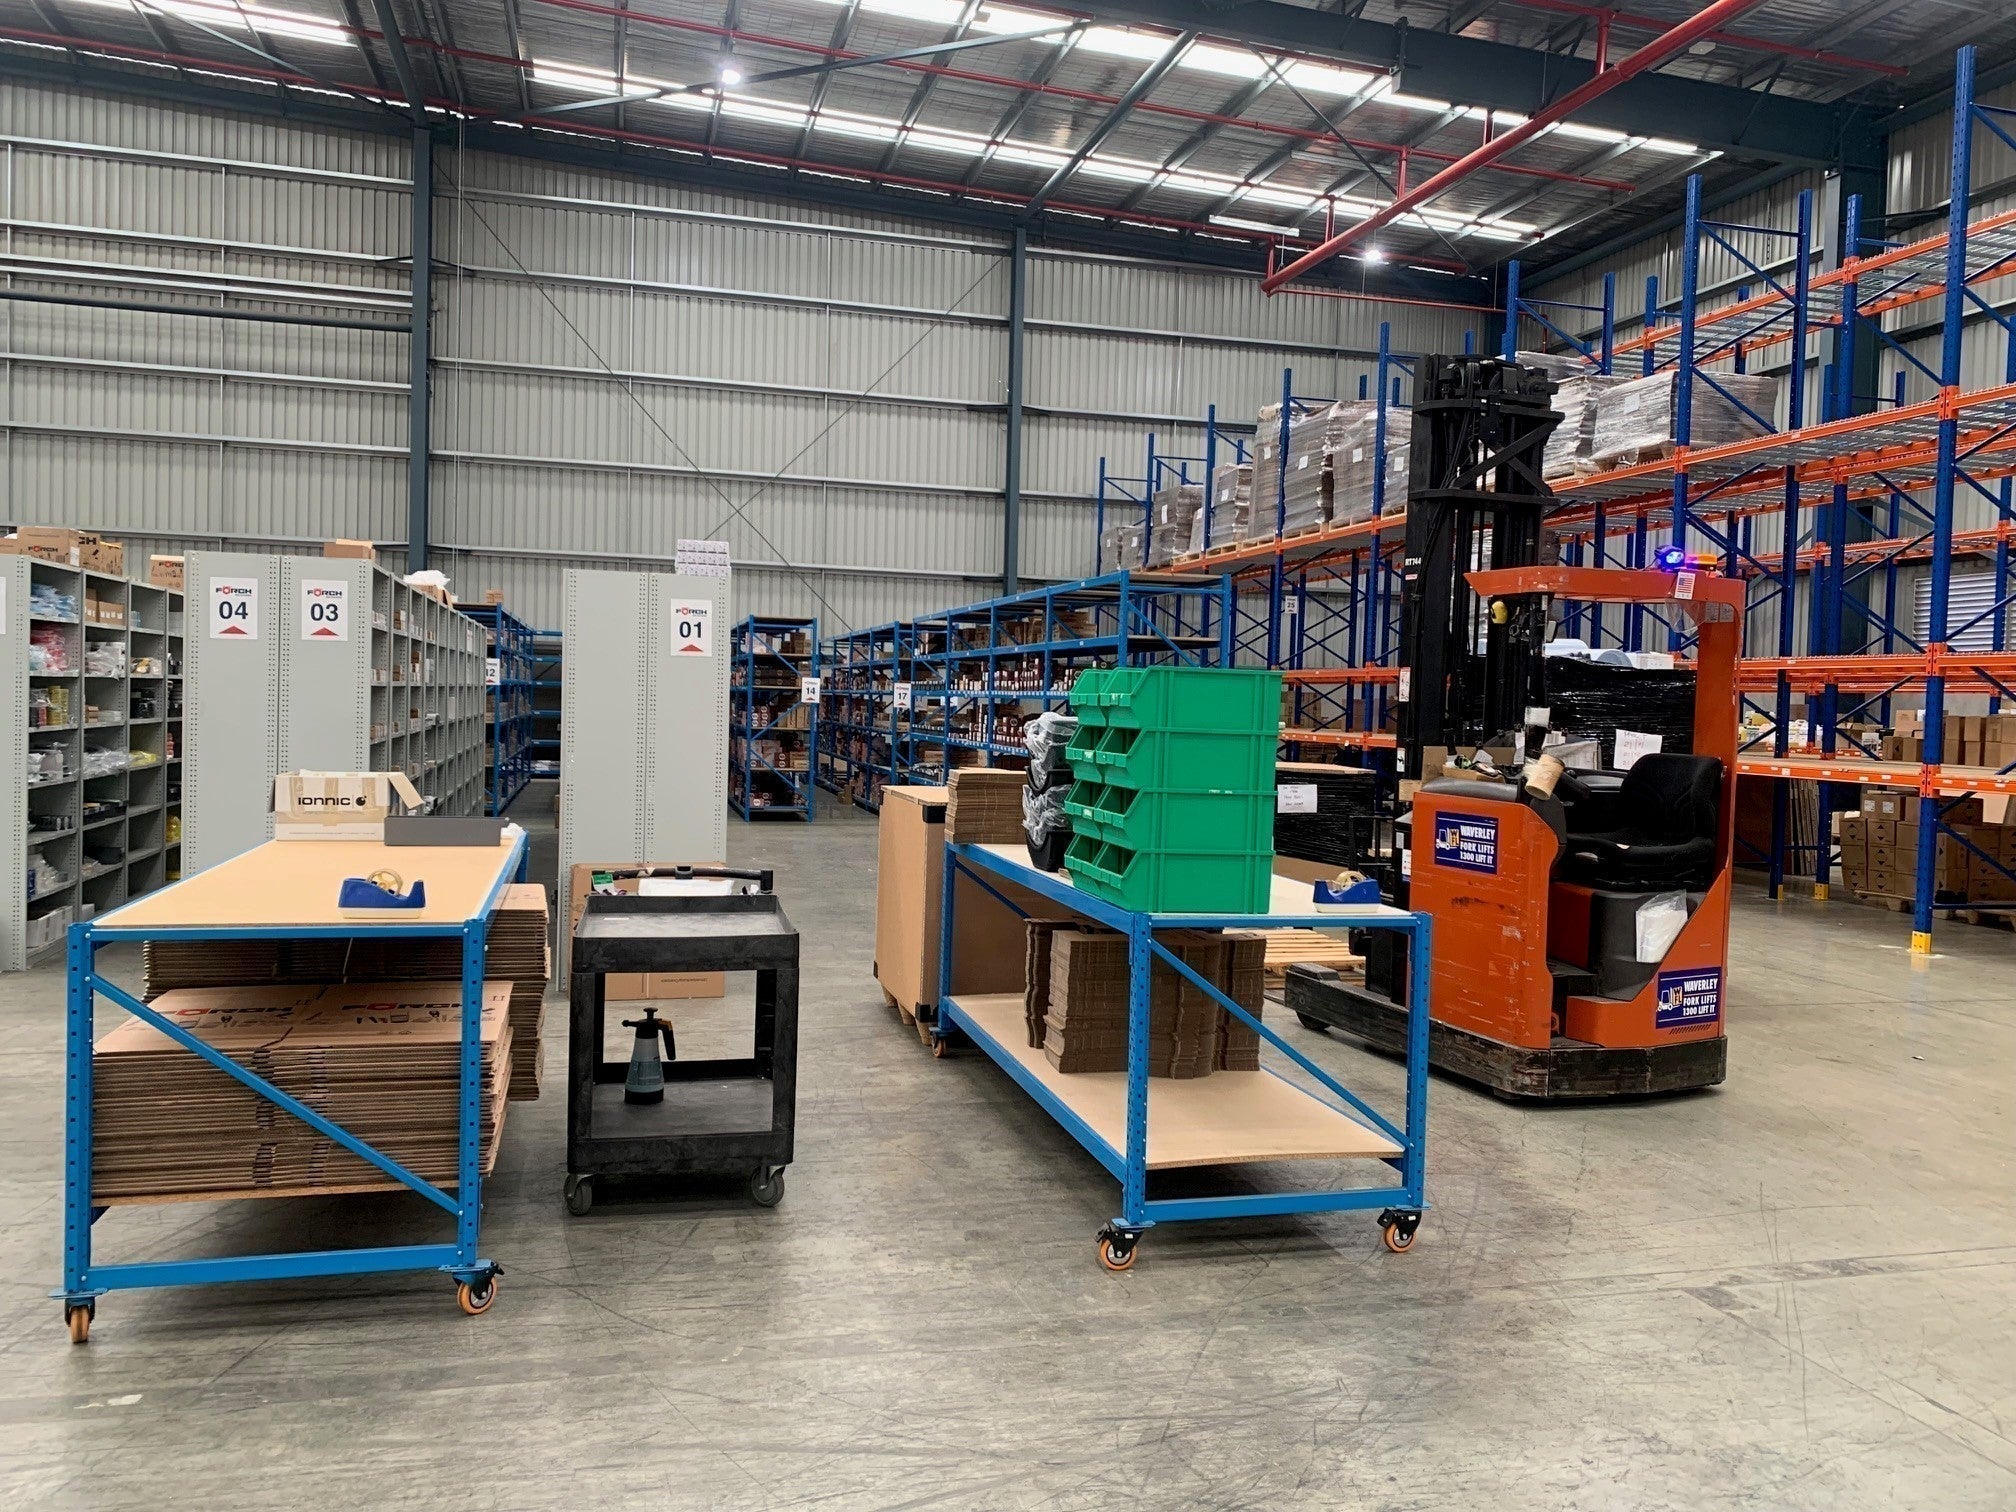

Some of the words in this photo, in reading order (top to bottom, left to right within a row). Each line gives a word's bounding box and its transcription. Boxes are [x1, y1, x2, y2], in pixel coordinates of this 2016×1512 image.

[219, 601, 248, 620] 04
[310, 603, 339, 621] 03
[679, 621, 702, 638] 01
[806, 687, 816, 695] 14
[898, 692, 908, 700] 17
[298, 797, 351, 806] ionnic
[1460, 825, 1496, 840] WAVERLEY
[1460, 841, 1477, 852] FORK
[1477, 843, 1495, 855] LIFTS
[1460, 851, 1475, 862] 1300
[1475, 853, 1487, 863] LIFT
[1487, 854, 1493, 864] IT
[1683, 978, 1719, 992] WAVERLEY
[1683, 996, 1700, 1007] FORK
[1700, 994, 1717, 1005] LIFTS
[1683, 1006, 1698, 1016] 1300
[1698, 1005, 1709, 1015] LIFT
[1709, 1004, 1716, 1013] IT
